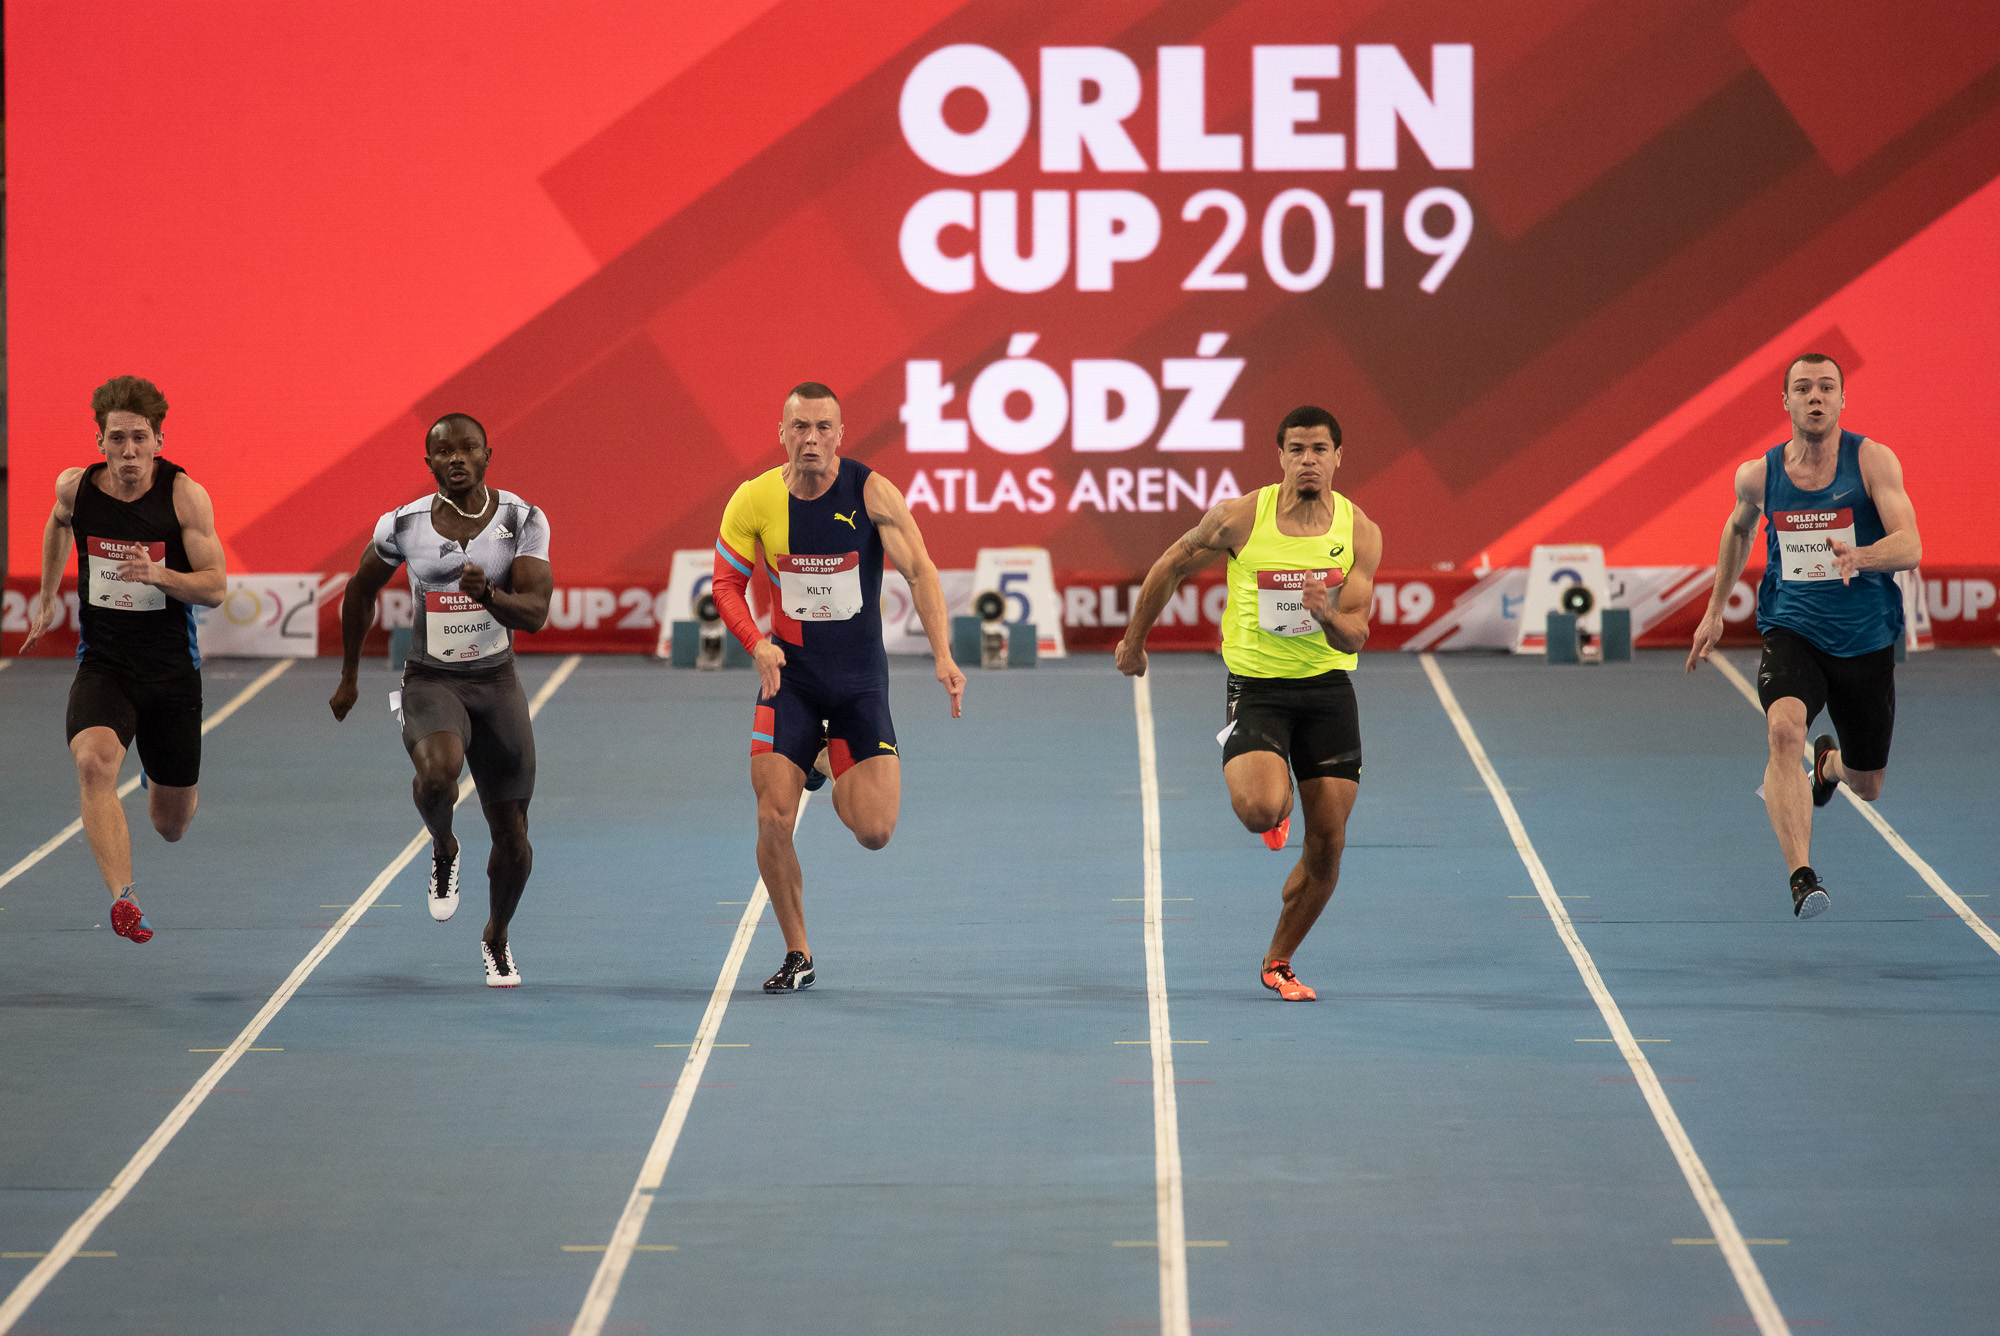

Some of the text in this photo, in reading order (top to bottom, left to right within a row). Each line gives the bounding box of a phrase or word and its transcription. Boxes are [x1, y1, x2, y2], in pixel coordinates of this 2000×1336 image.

[899, 43, 1475, 176] ORLEN
[899, 187, 1475, 293] CUP 2019
[900, 333, 1245, 455] ŁÓDŹ
[906, 467, 1243, 513] ATLAS ARENA
[1786, 512, 1837, 523] ORLEN CUP
[792, 557, 844, 566] ORLEN CUP
[1786, 543, 1833, 553] KWIATKOW
[807, 586, 832, 595] KILTY
[1273, 572, 1328, 582] ORLEN UP
[2, 590, 80, 632] 201
[439, 595, 473, 604] ORLEN
[542, 587, 617, 630] UP
[999, 573, 1030, 625] 5
[1277, 602, 1305, 611] ROBIN
[1927, 579, 1996, 621] UP
[443, 621, 491, 634] BOCKARIE
